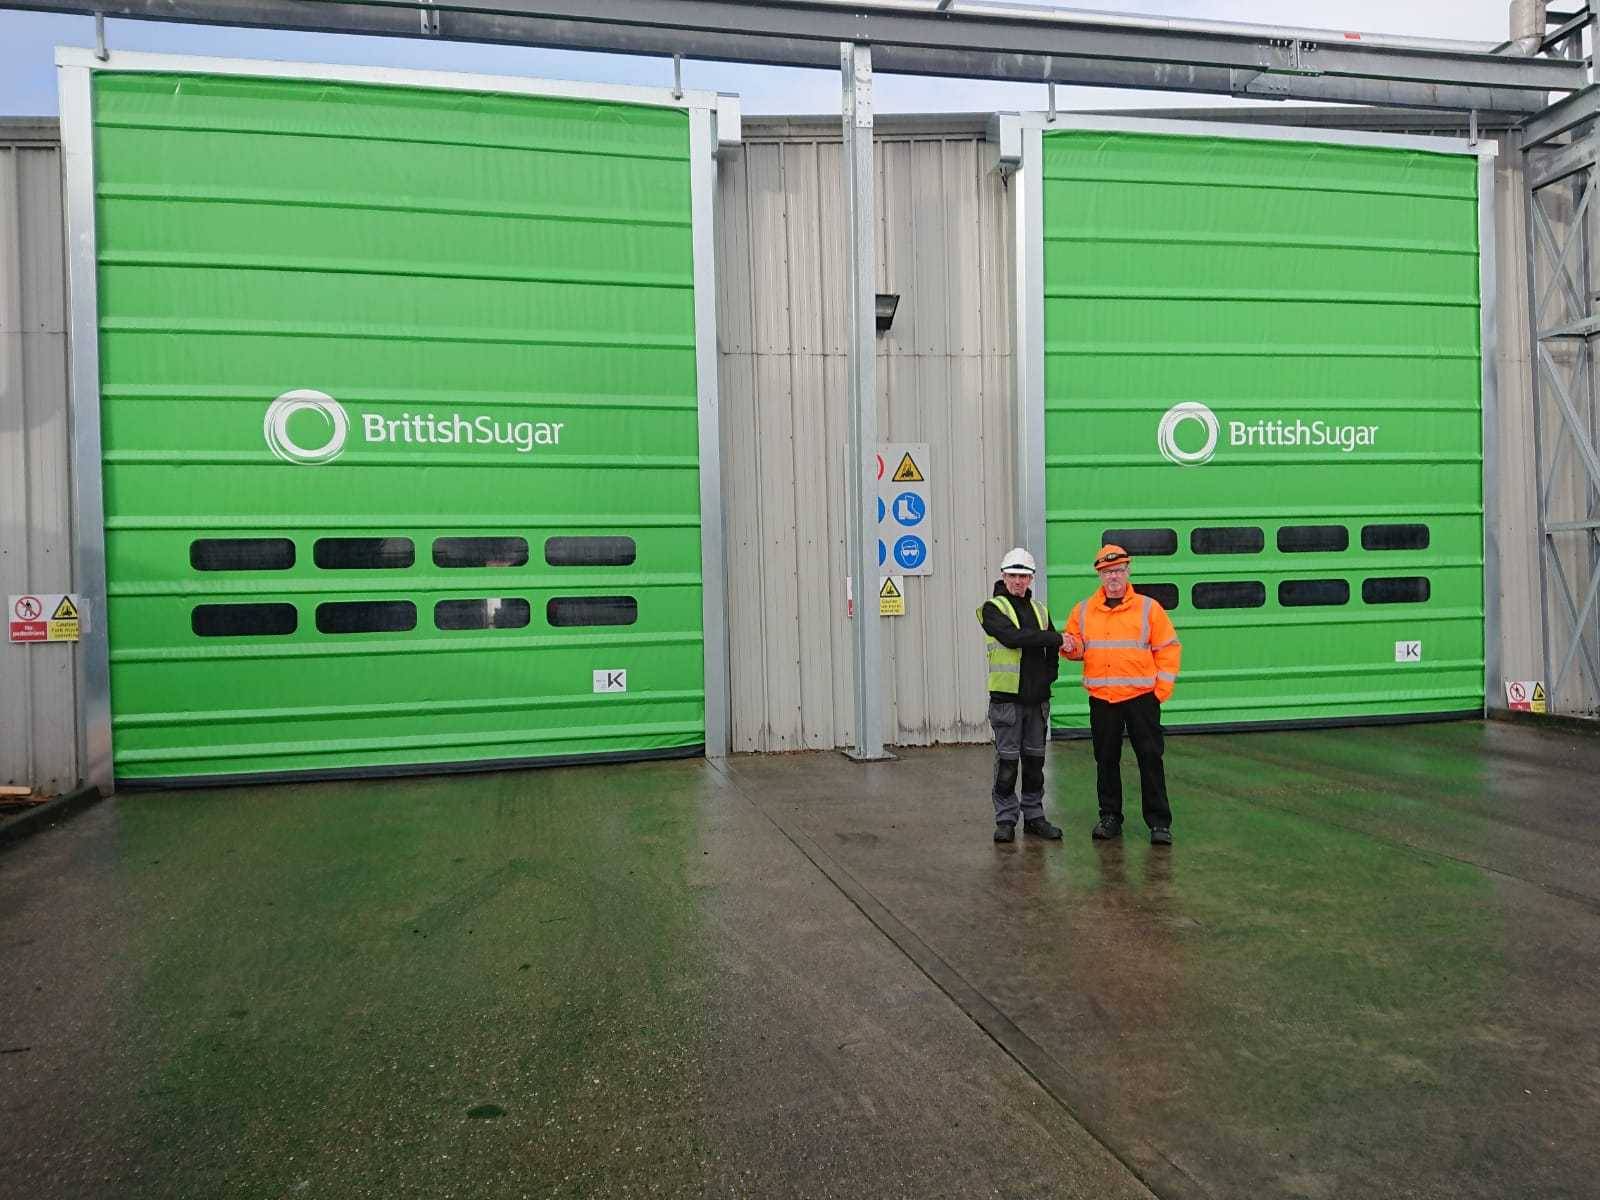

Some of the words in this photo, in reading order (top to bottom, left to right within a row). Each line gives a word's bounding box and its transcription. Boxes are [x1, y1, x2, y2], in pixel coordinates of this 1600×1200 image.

[362, 413, 564, 452] BritishSugar
[1228, 419, 1379, 452] BritishSugar
[607, 672, 624, 688] K
